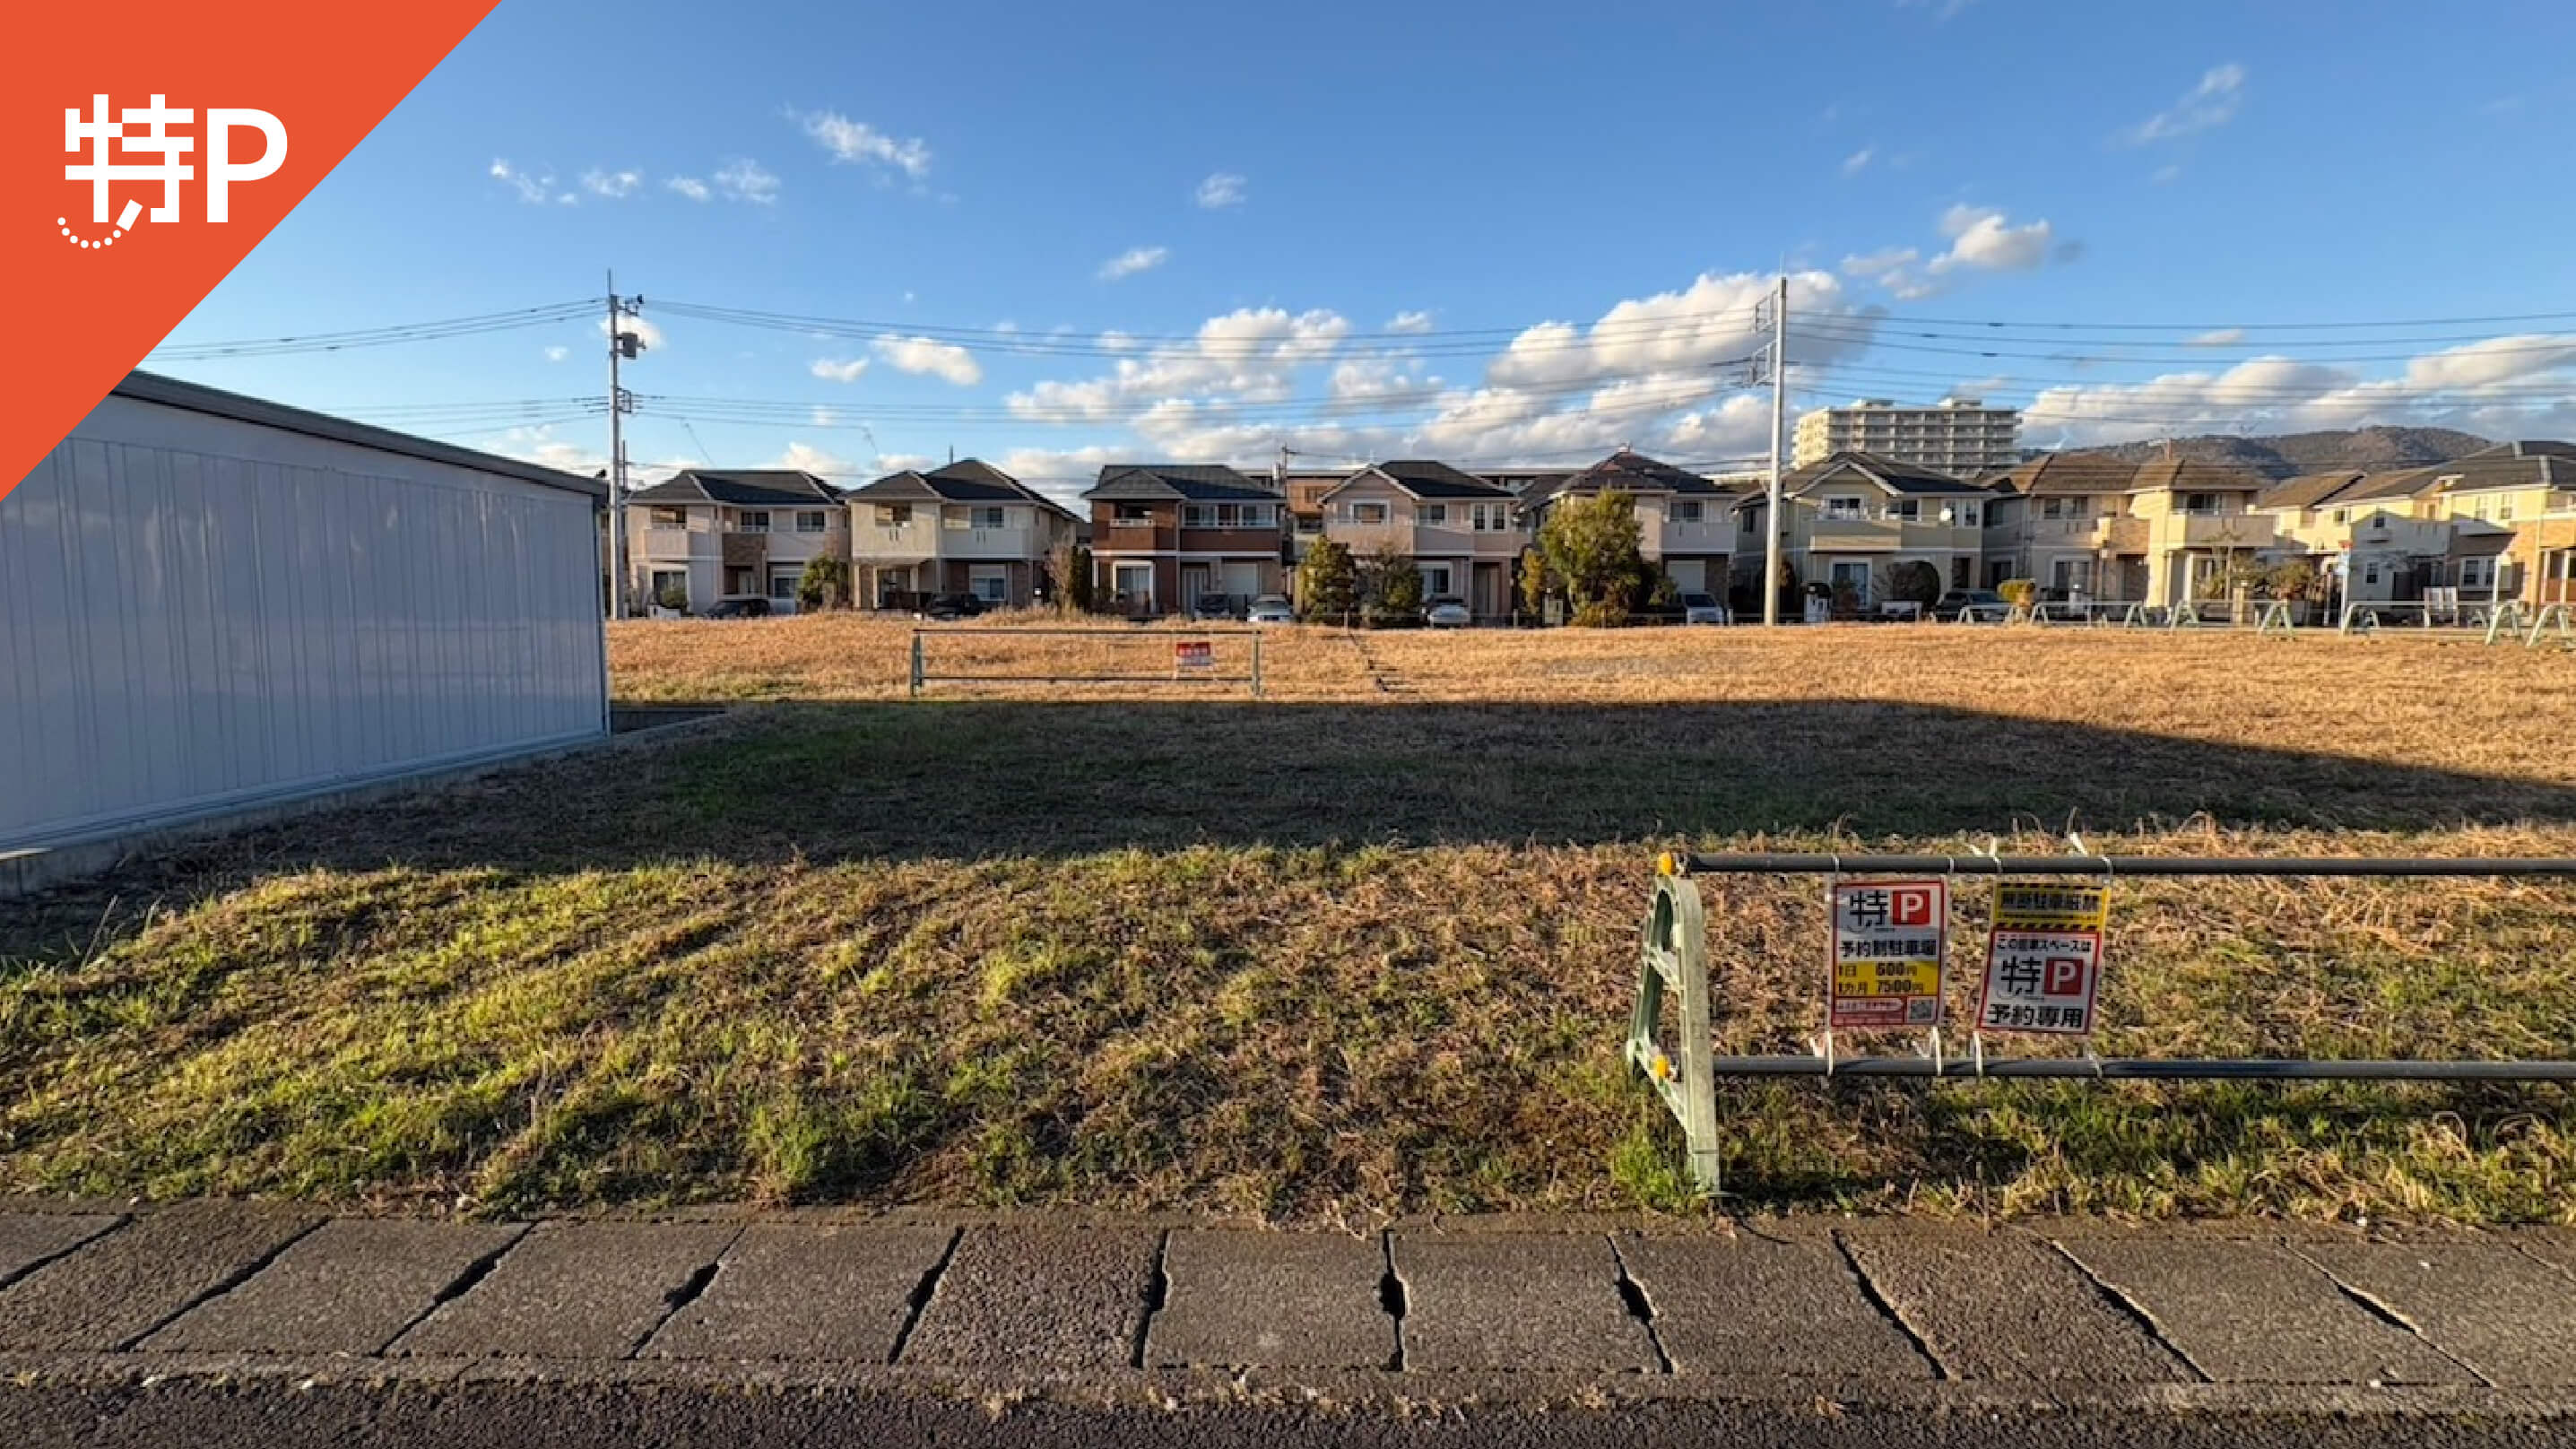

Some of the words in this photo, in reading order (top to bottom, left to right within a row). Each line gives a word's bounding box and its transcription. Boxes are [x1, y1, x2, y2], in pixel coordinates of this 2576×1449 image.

[1849, 889, 1924, 927] 特P
[2000, 956, 2077, 995] 特P
[1987, 1004, 2084, 1028] 予約専用
